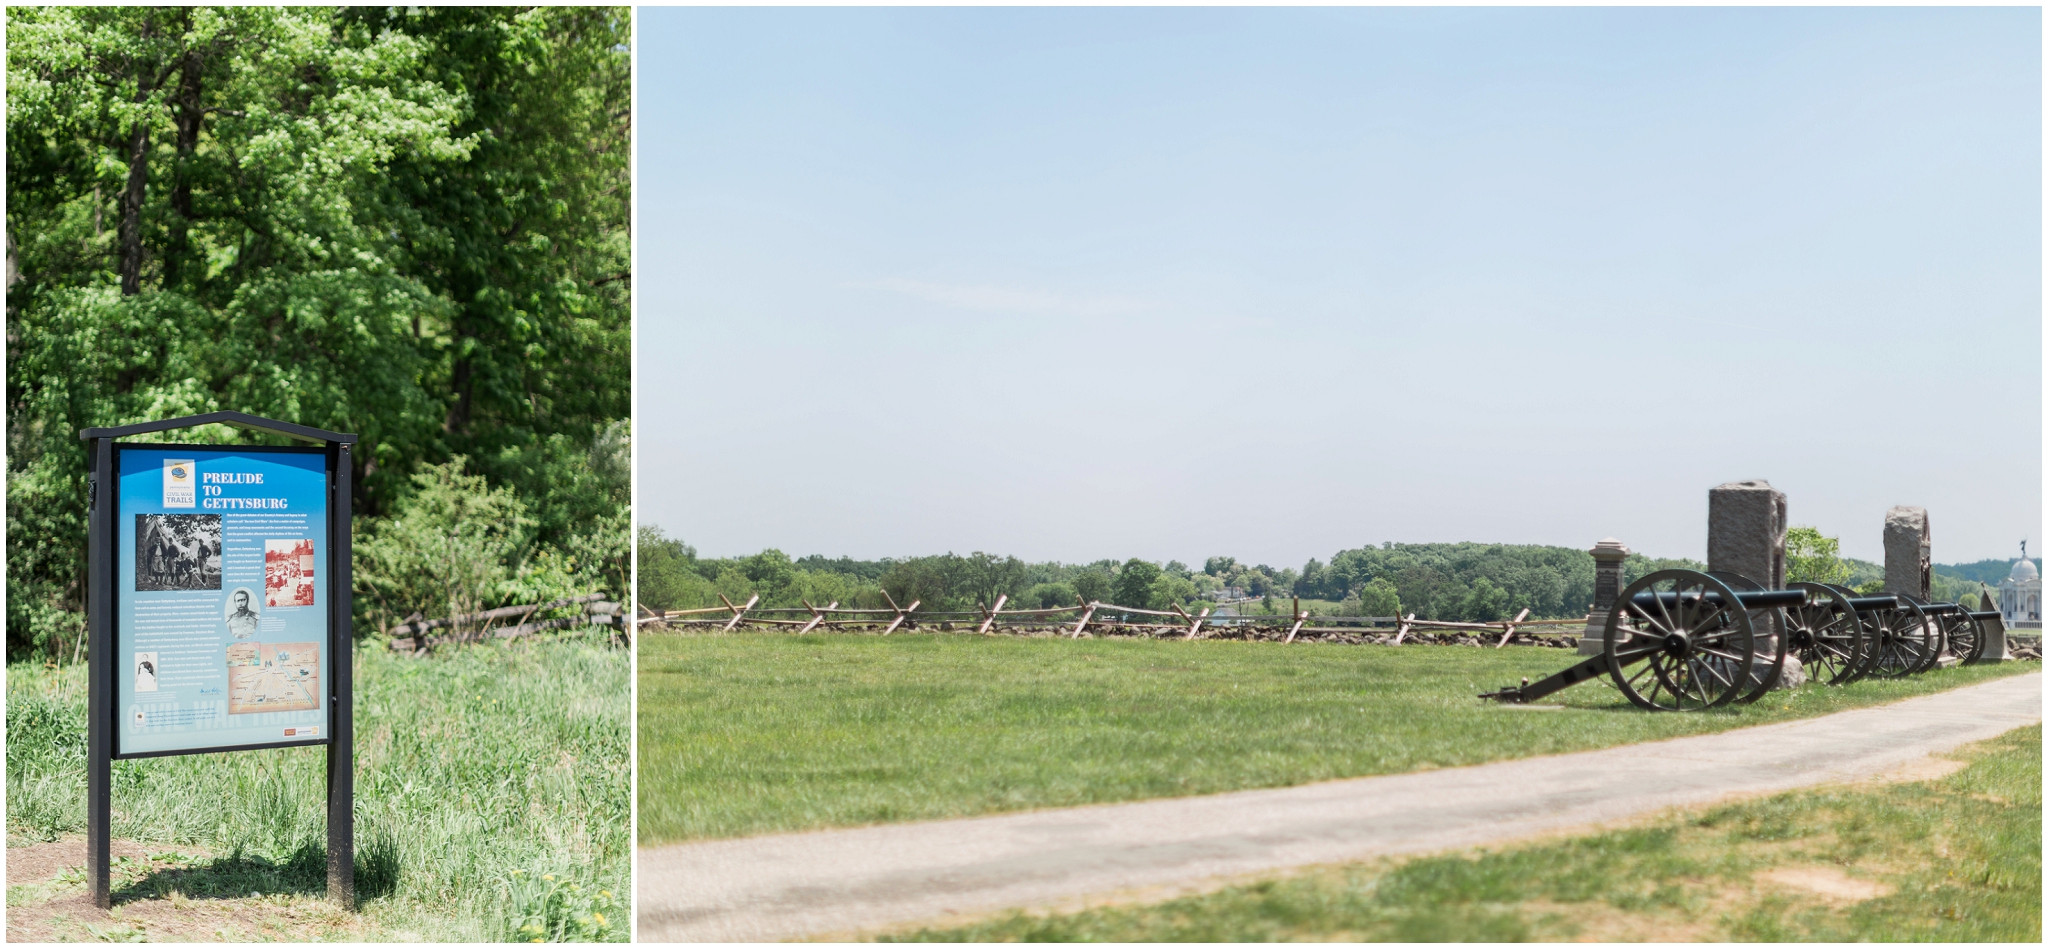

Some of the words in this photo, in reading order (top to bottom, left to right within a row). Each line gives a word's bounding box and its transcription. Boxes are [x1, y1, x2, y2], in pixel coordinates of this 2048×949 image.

[203, 472, 264, 484] PRELUDE
[202, 485, 222, 496] TO
[166, 496, 193, 504] TRAILS
[203, 497, 288, 509] GETTYSBURG
